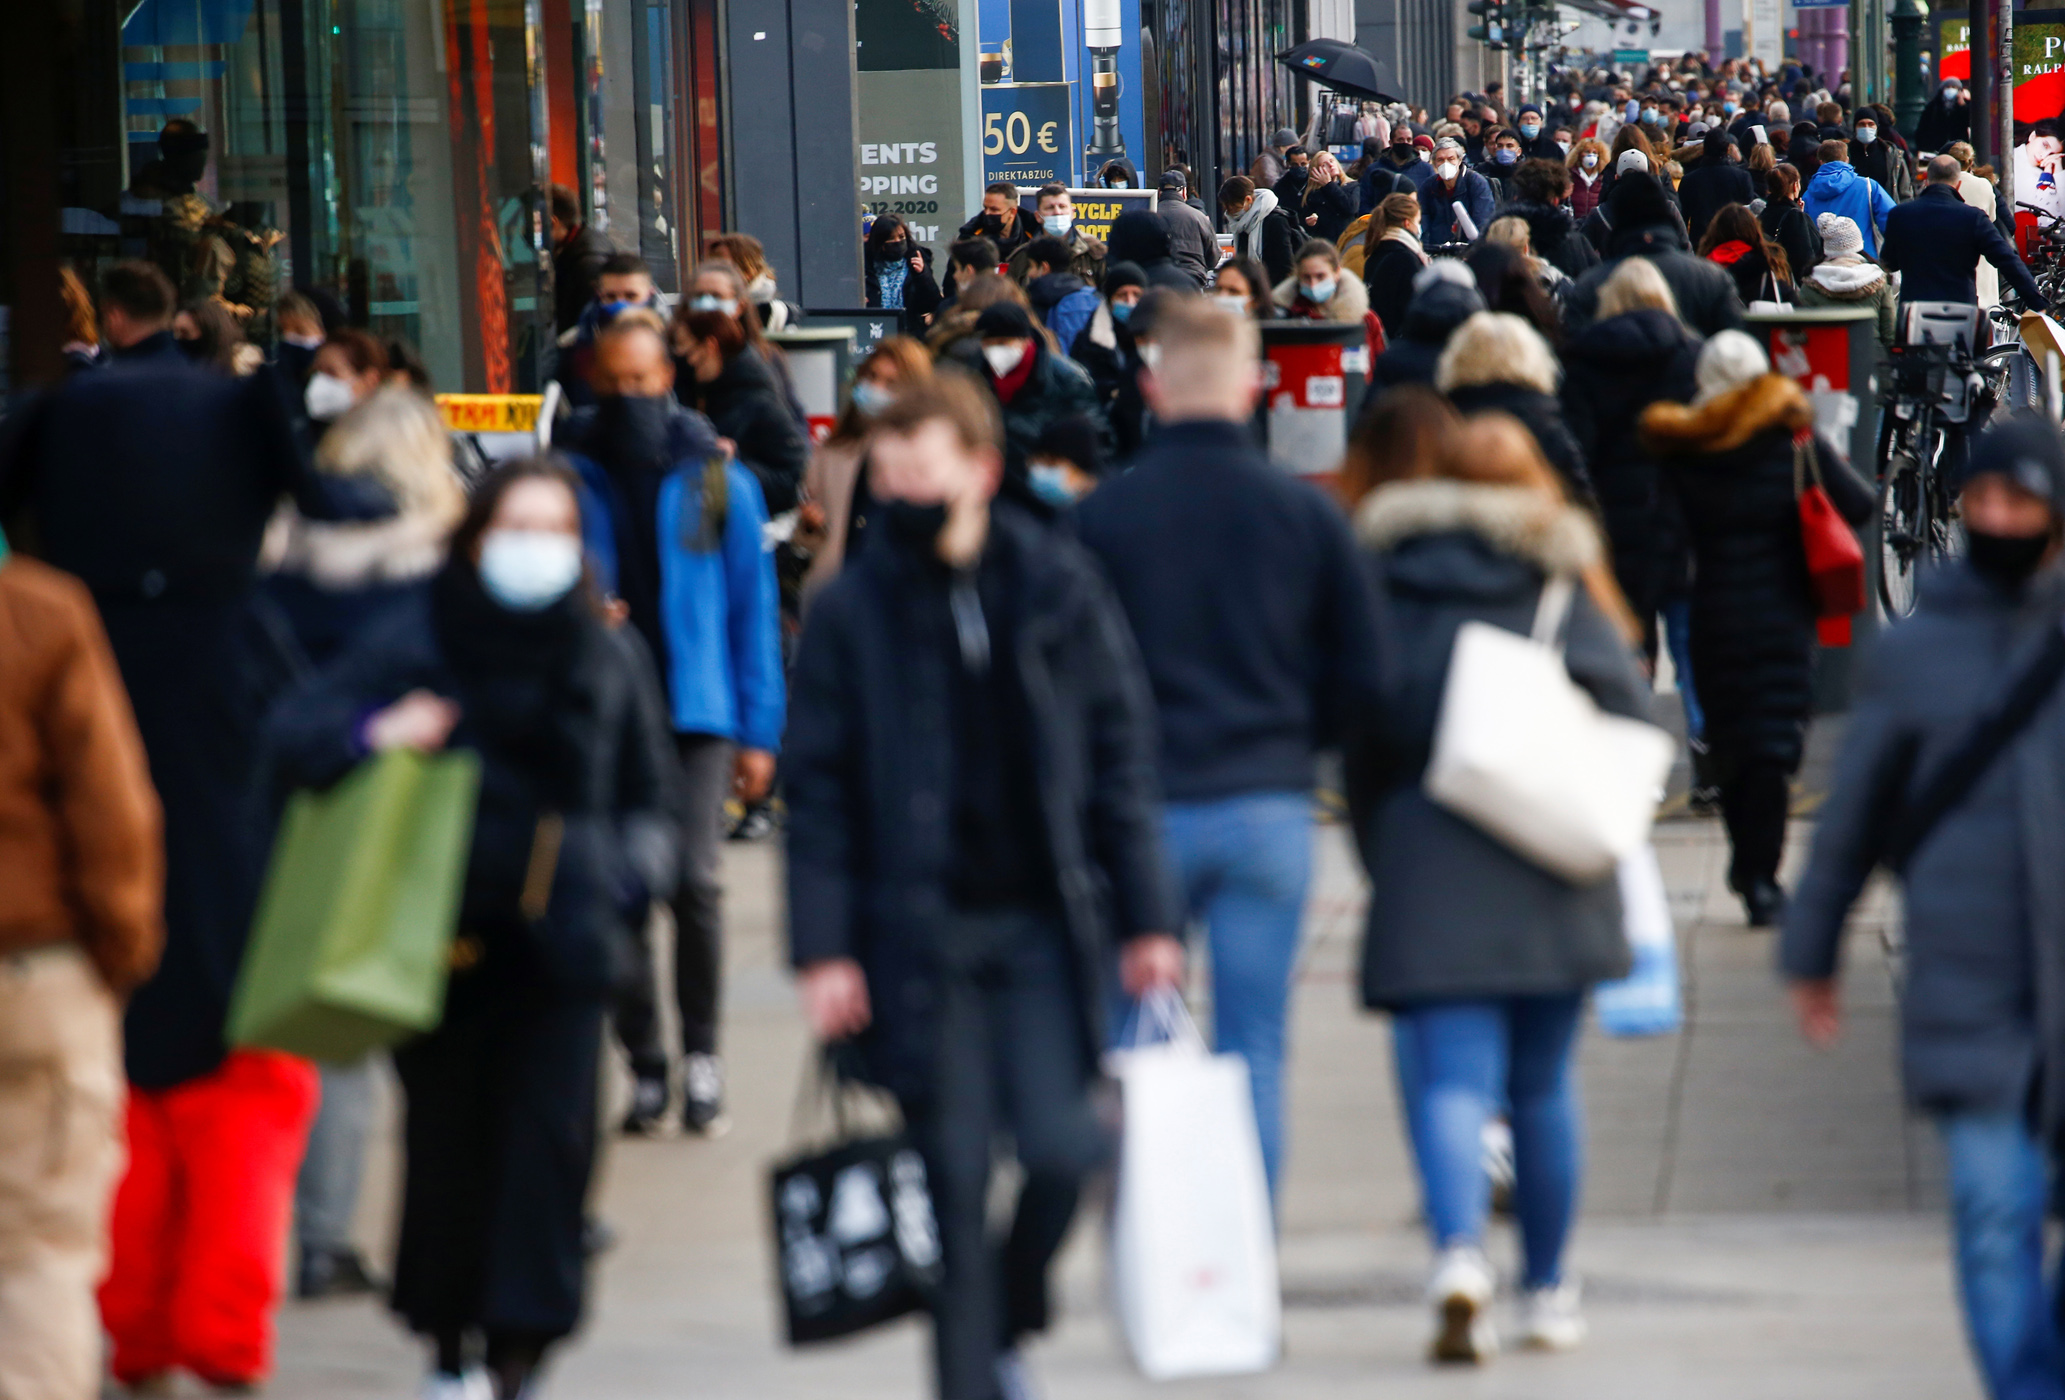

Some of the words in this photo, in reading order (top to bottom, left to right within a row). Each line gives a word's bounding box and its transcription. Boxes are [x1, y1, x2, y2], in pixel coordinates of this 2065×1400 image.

[2023, 63, 2065, 75] RALP
[984, 111, 1031, 156] 50
[1037, 121, 1059, 154] €
[988, 169, 1054, 181] DIREKTABZUG
[905, 221, 940, 242] hr
